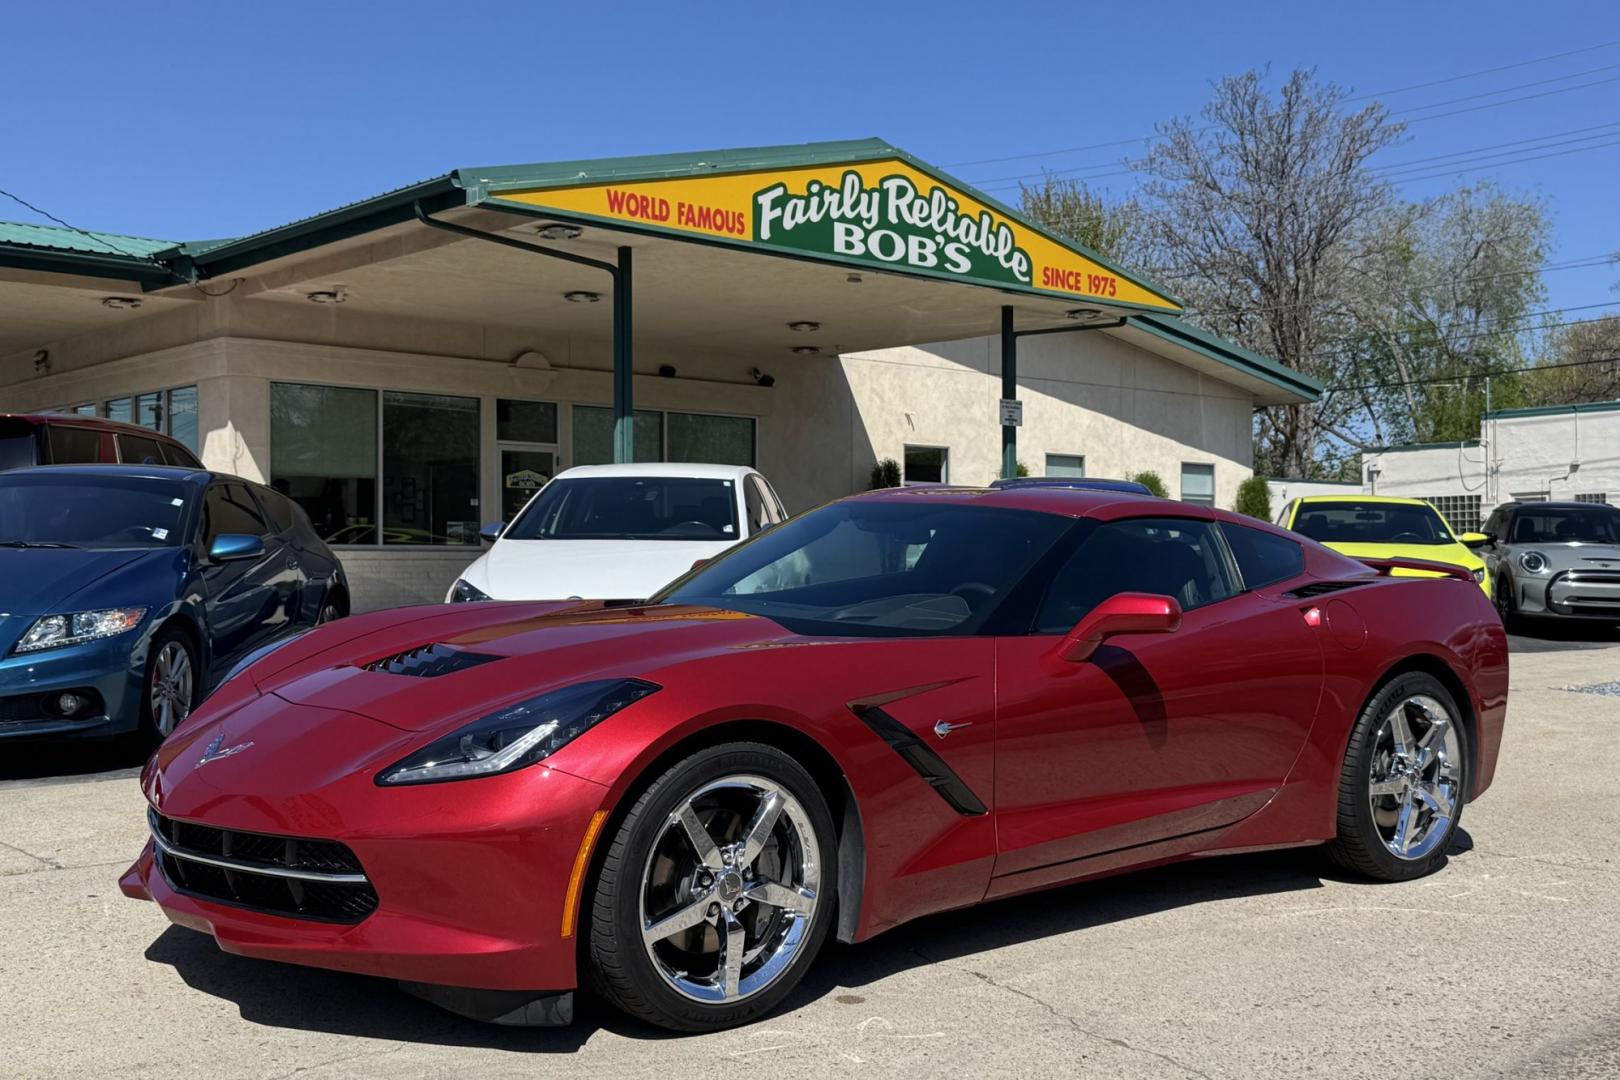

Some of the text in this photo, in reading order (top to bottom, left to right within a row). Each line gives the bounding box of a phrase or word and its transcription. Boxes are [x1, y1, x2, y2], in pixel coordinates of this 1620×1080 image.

[606, 189, 745, 235] WORLD FAMOUS
[757, 174, 1030, 282] Fairly Reliable
[833, 222, 972, 273] BOB'S
[1042, 266, 1117, 297] SINCE 1975
